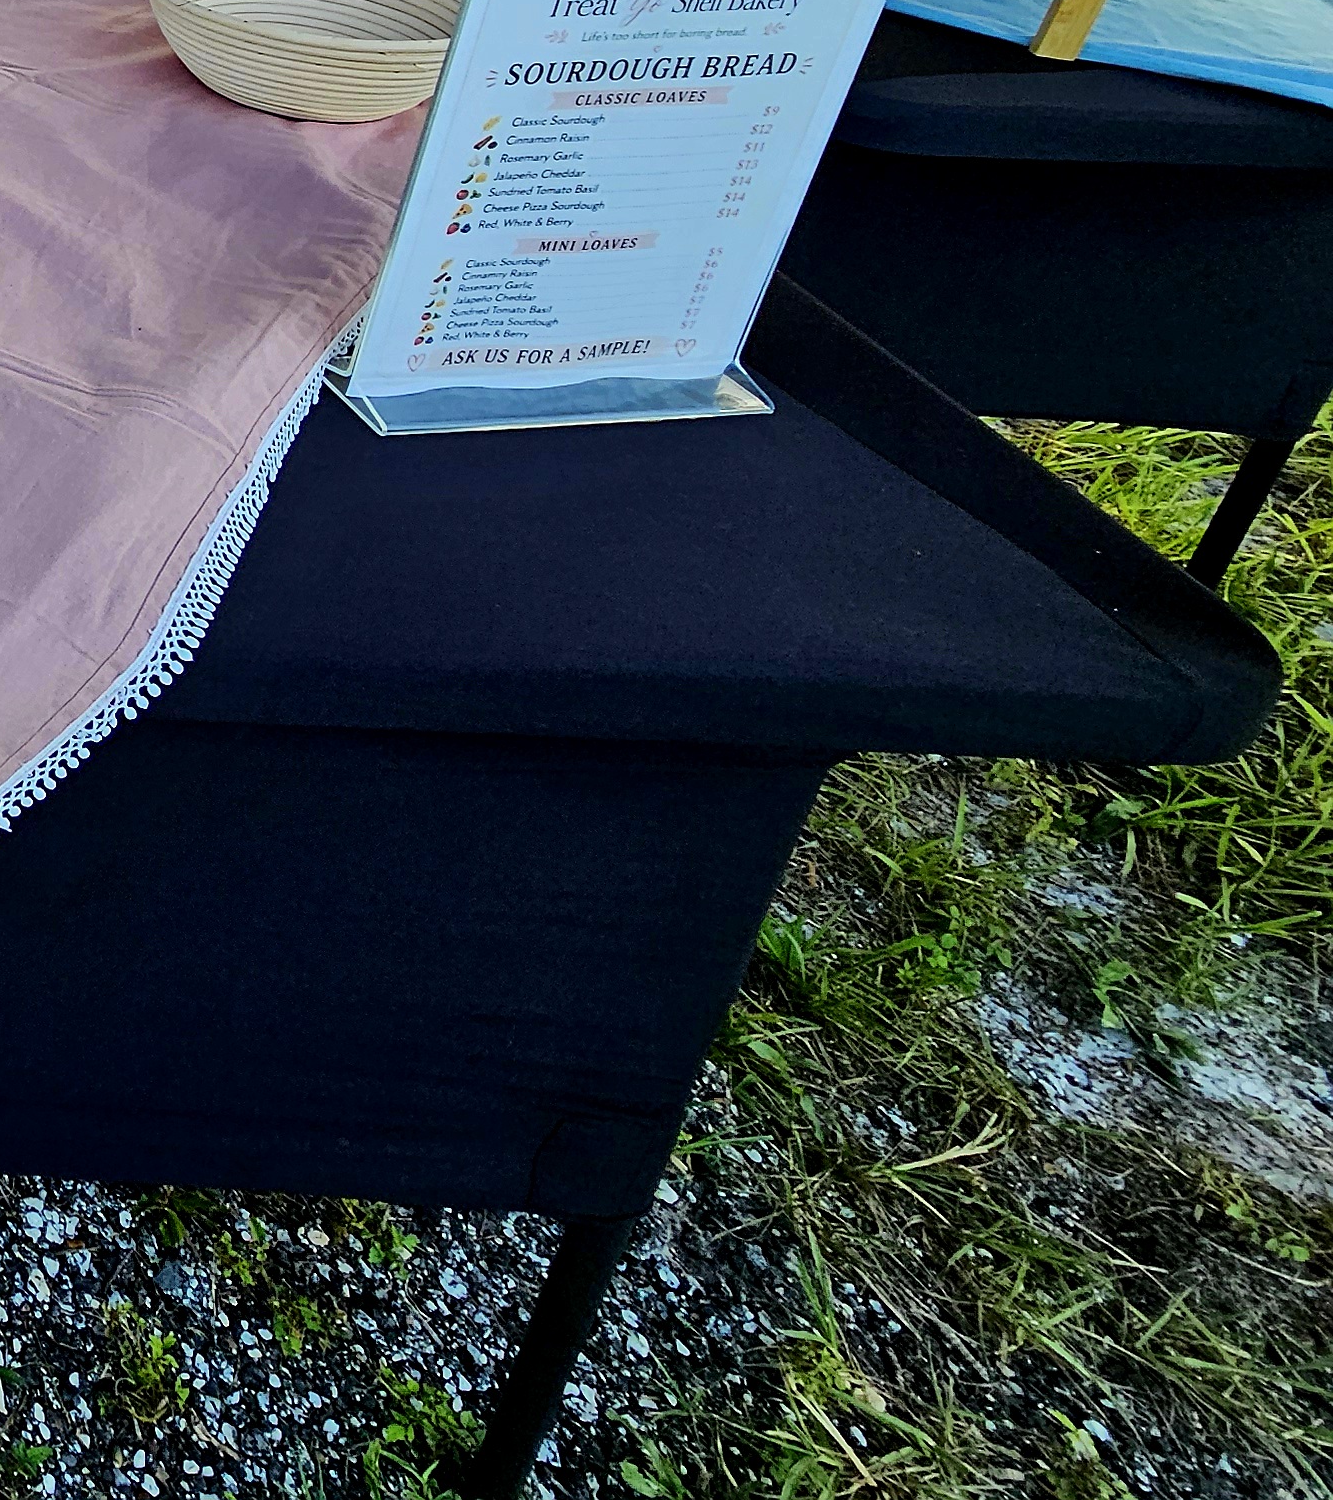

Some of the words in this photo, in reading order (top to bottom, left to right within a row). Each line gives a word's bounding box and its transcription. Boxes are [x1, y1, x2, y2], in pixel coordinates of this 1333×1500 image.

[581, 30, 609, 42] Life's
[611, 31, 629, 41] too
[632, 29, 659, 41] short
[662, 28, 677, 39] for
[679, 28, 714, 41] boring
[716, 26, 747, 38] bread.
[504, 55, 696, 87] SOURDOUGH
[701, 52, 798, 79] BREAD
[575, 90, 641, 106] CLASSIC
[646, 90, 708, 103] LOAVES
[512, 117, 547, 128] Classic
[550, 114, 606, 127] Sourdough
[763, 105, 781, 117] $9
[506, 135, 558, 145] Cinnamon
[560, 133, 590, 143] Raisin
[750, 124, 773, 135] $12
[500, 153, 551, 165] Rosemary
[553, 151, 584, 161] Garlic
[743, 142, 765, 153] $11
[493, 170, 538, 182] Jalapeño
[541, 169, 585, 179] Cheddar
[488, 186, 534, 197] Sundried
[536, 185, 572, 195] Tomato
[575, 183, 599, 194] Basil
[730, 175, 752, 186] $14
[483, 203, 520, 213] Cheese
[522, 202, 547, 211] Pizza
[550, 200, 605, 213] Sourdough
[723, 192, 746, 203] $14
[503, 218, 533, 228] White
[535, 217, 543, 227] &
[546, 216, 574, 228] Berry
[717, 208, 740, 219] $14
[538, 240, 576, 252] MINI
[581, 237, 638, 251] LOAVES
[466, 259, 497, 269] Classic
[499, 257, 551, 268] Sourdough
[510, 269, 538, 278] Raisin
[458, 283, 502, 293] Rosemary
[504, 281, 535, 290] Garlic
[495, 293, 537, 302] Cheddar
[492, 306, 526, 315] Tomato
[529, 305, 553, 314] Basil
[446, 320, 478, 330] Cheese
[507, 317, 559, 328] Sourdough
[464, 331, 490, 340] White
[503, 329, 530, 340] Berry
[441, 350, 479, 366] ASK
[484, 349, 510, 364] US
[516, 349, 554, 365] FOR
[559, 348, 571, 363] A
[577, 339, 651, 361] SAMPLE!
